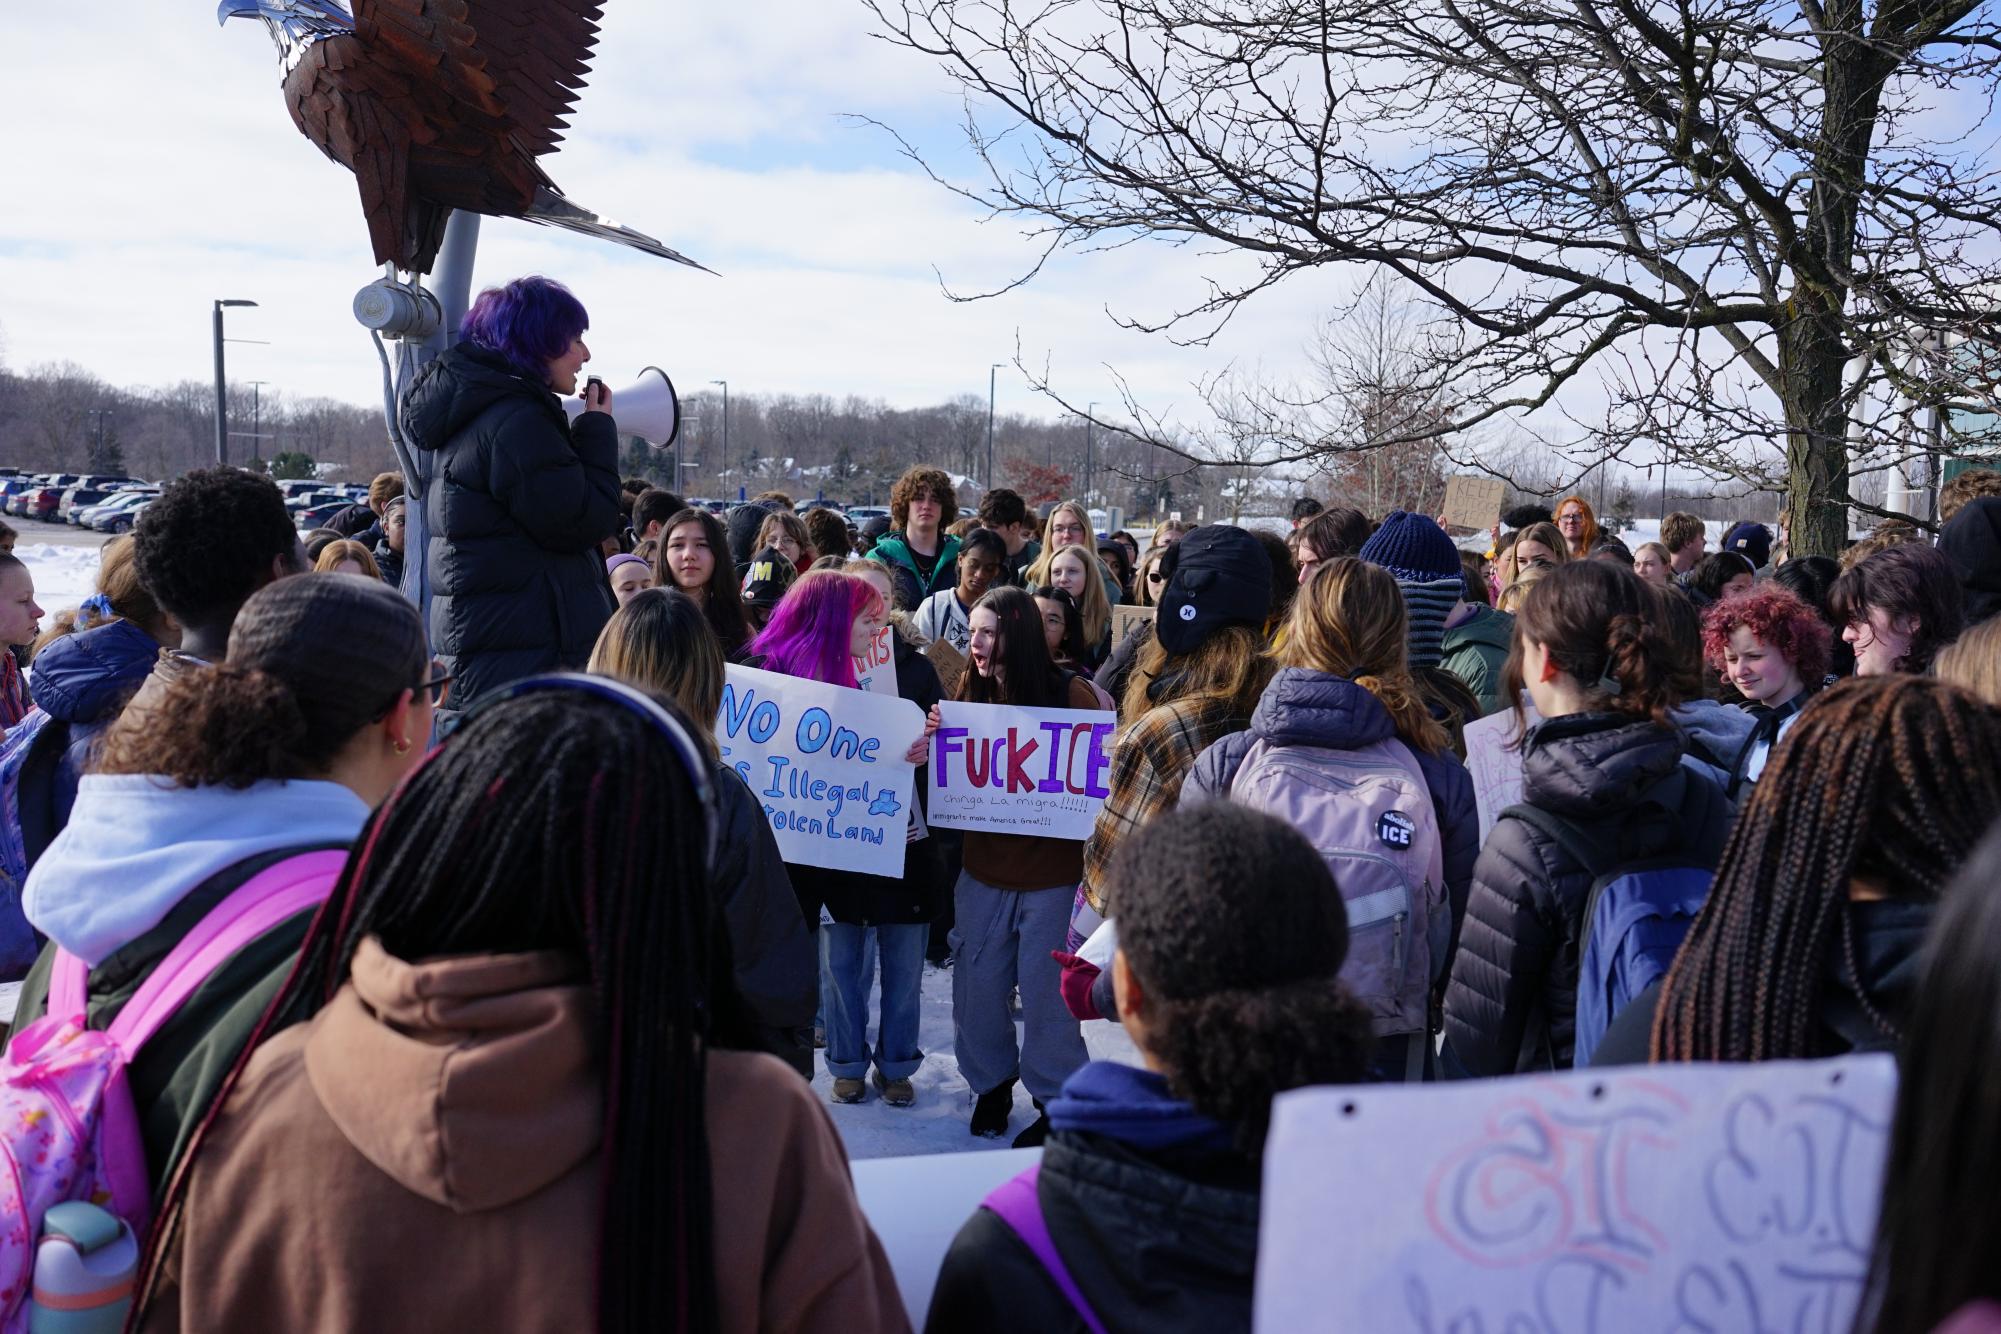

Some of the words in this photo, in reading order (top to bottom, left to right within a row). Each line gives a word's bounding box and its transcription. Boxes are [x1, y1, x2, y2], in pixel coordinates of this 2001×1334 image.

[796, 707, 880, 763] One
[1038, 721, 1115, 799] ICE
[763, 756, 869, 817] Illegal
[827, 817, 884, 845] Land
[1382, 825, 1410, 845] ICE
